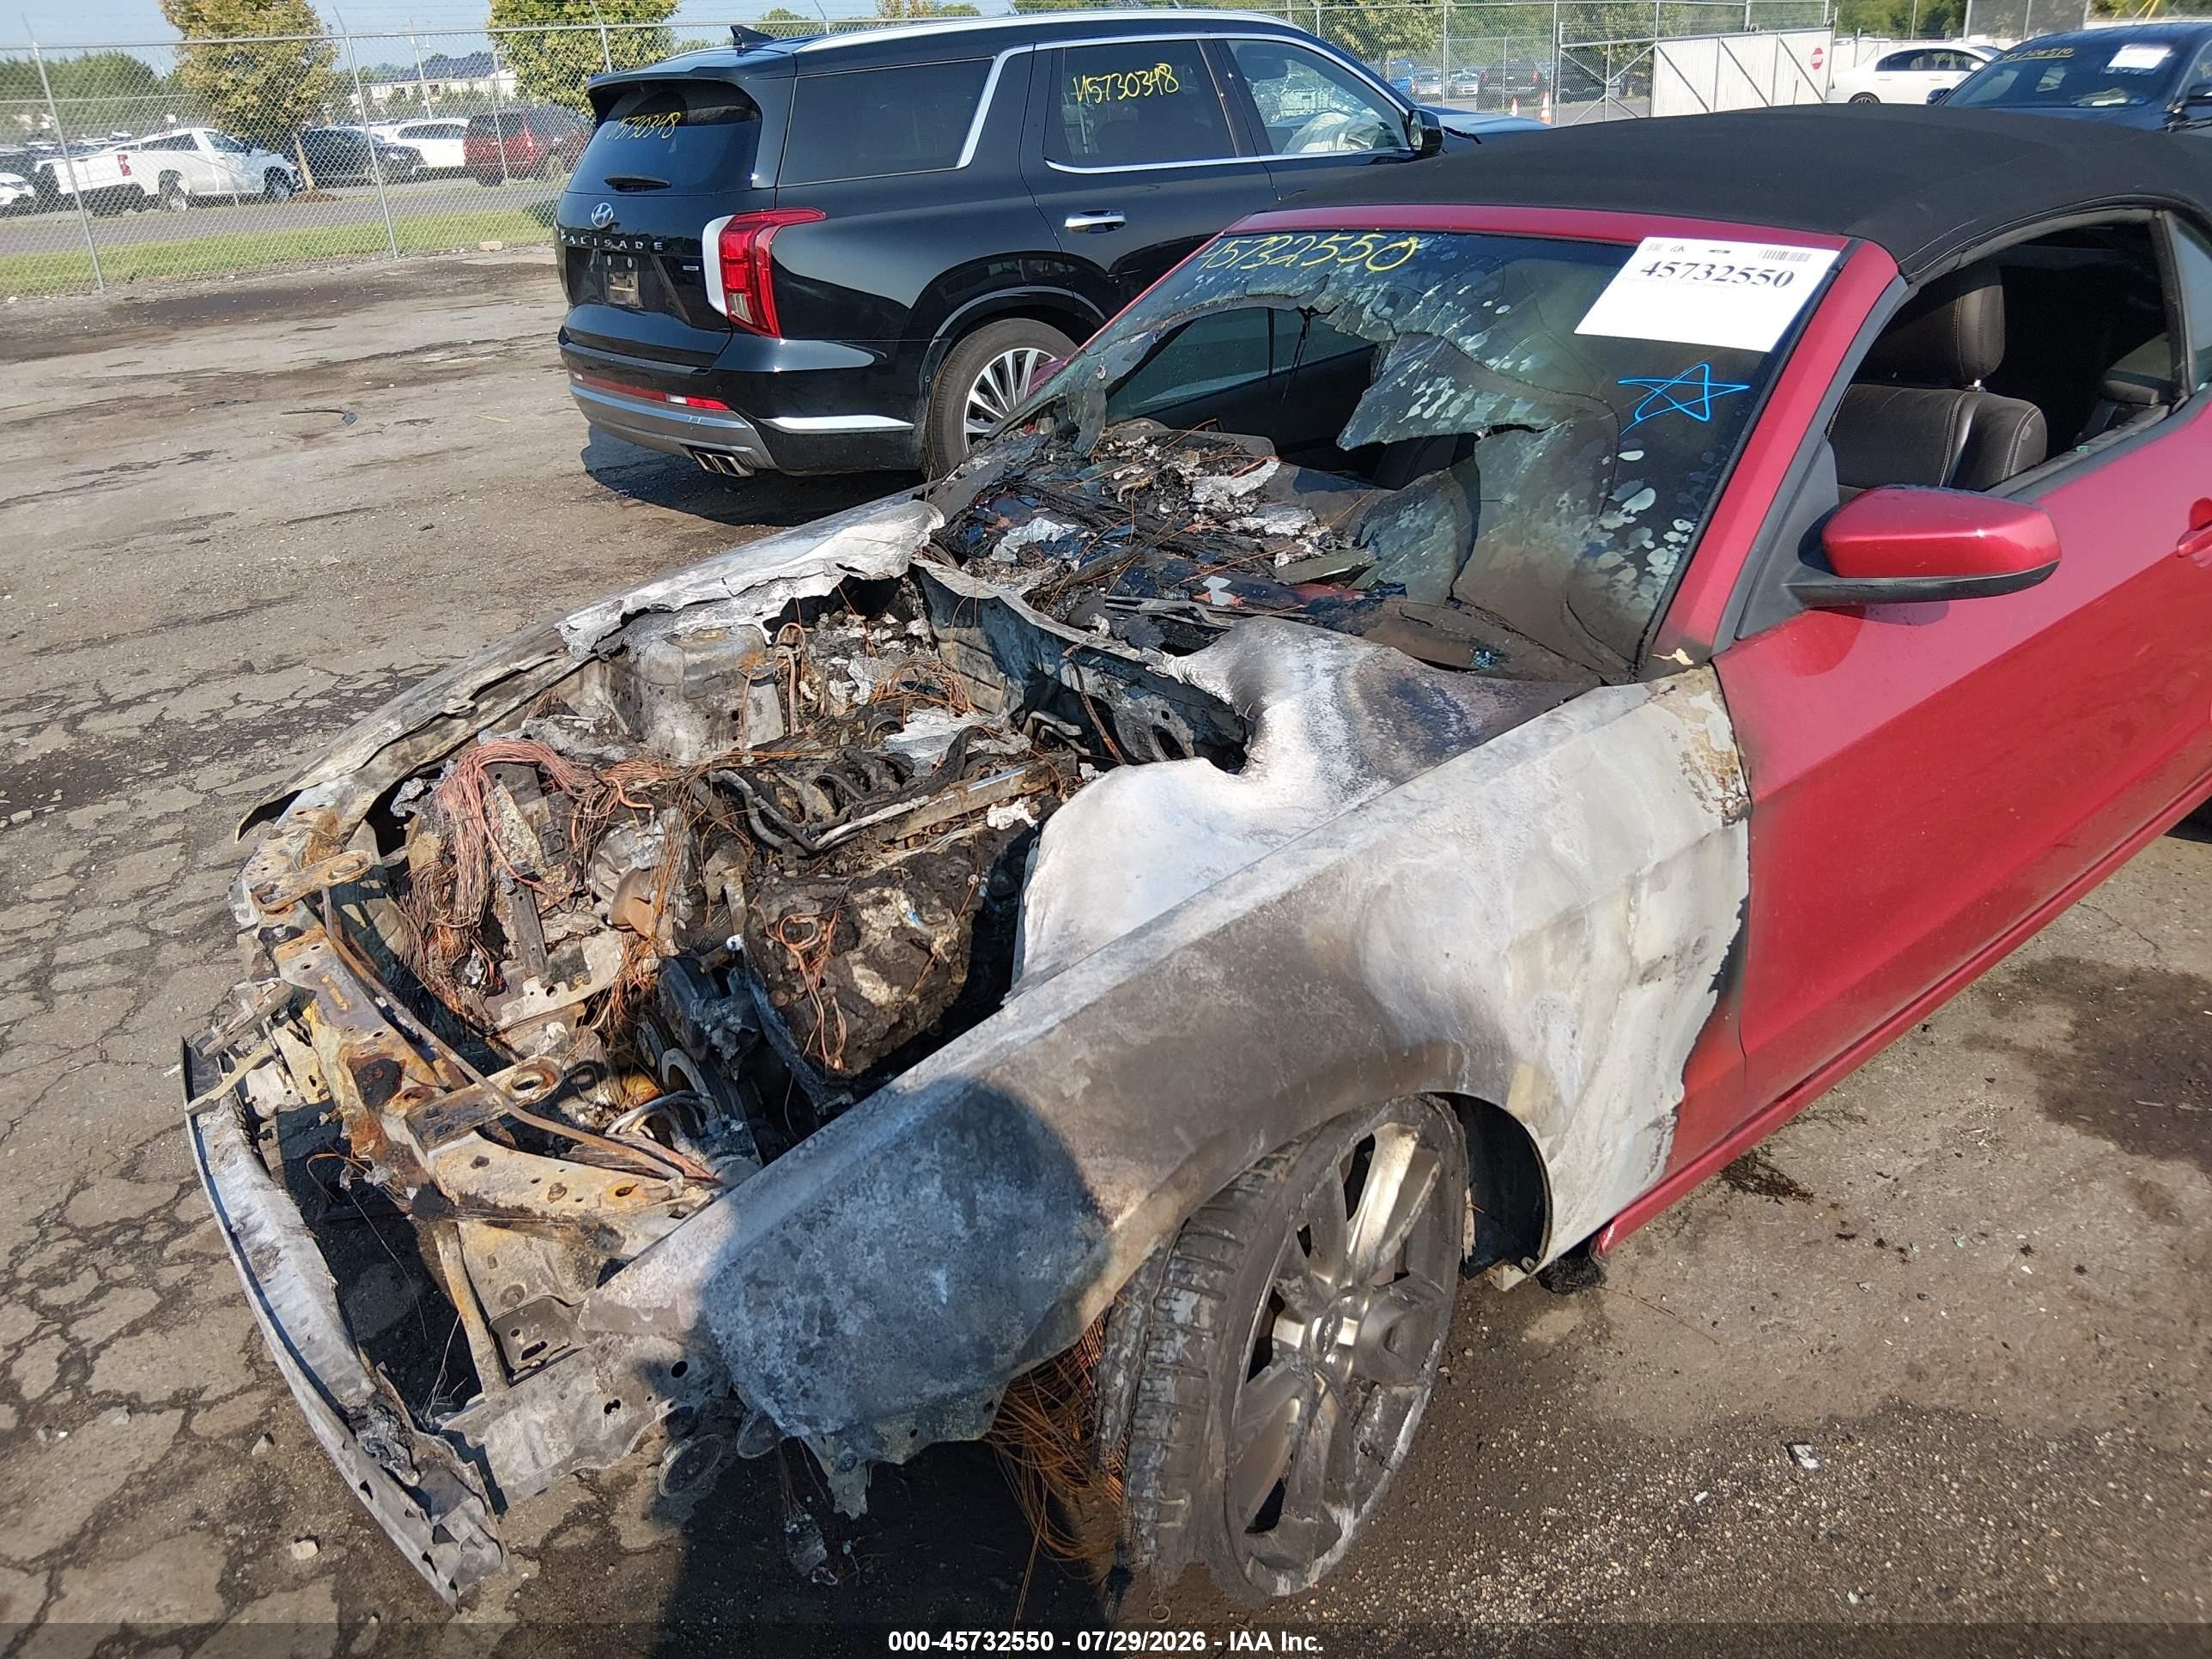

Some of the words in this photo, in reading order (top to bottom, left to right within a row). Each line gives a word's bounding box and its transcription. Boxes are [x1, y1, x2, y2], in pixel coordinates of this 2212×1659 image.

[560, 230, 664, 251] PALISADE
[1197, 233, 1419, 271] 45732550
[1640, 260, 1795, 289] 45732550
